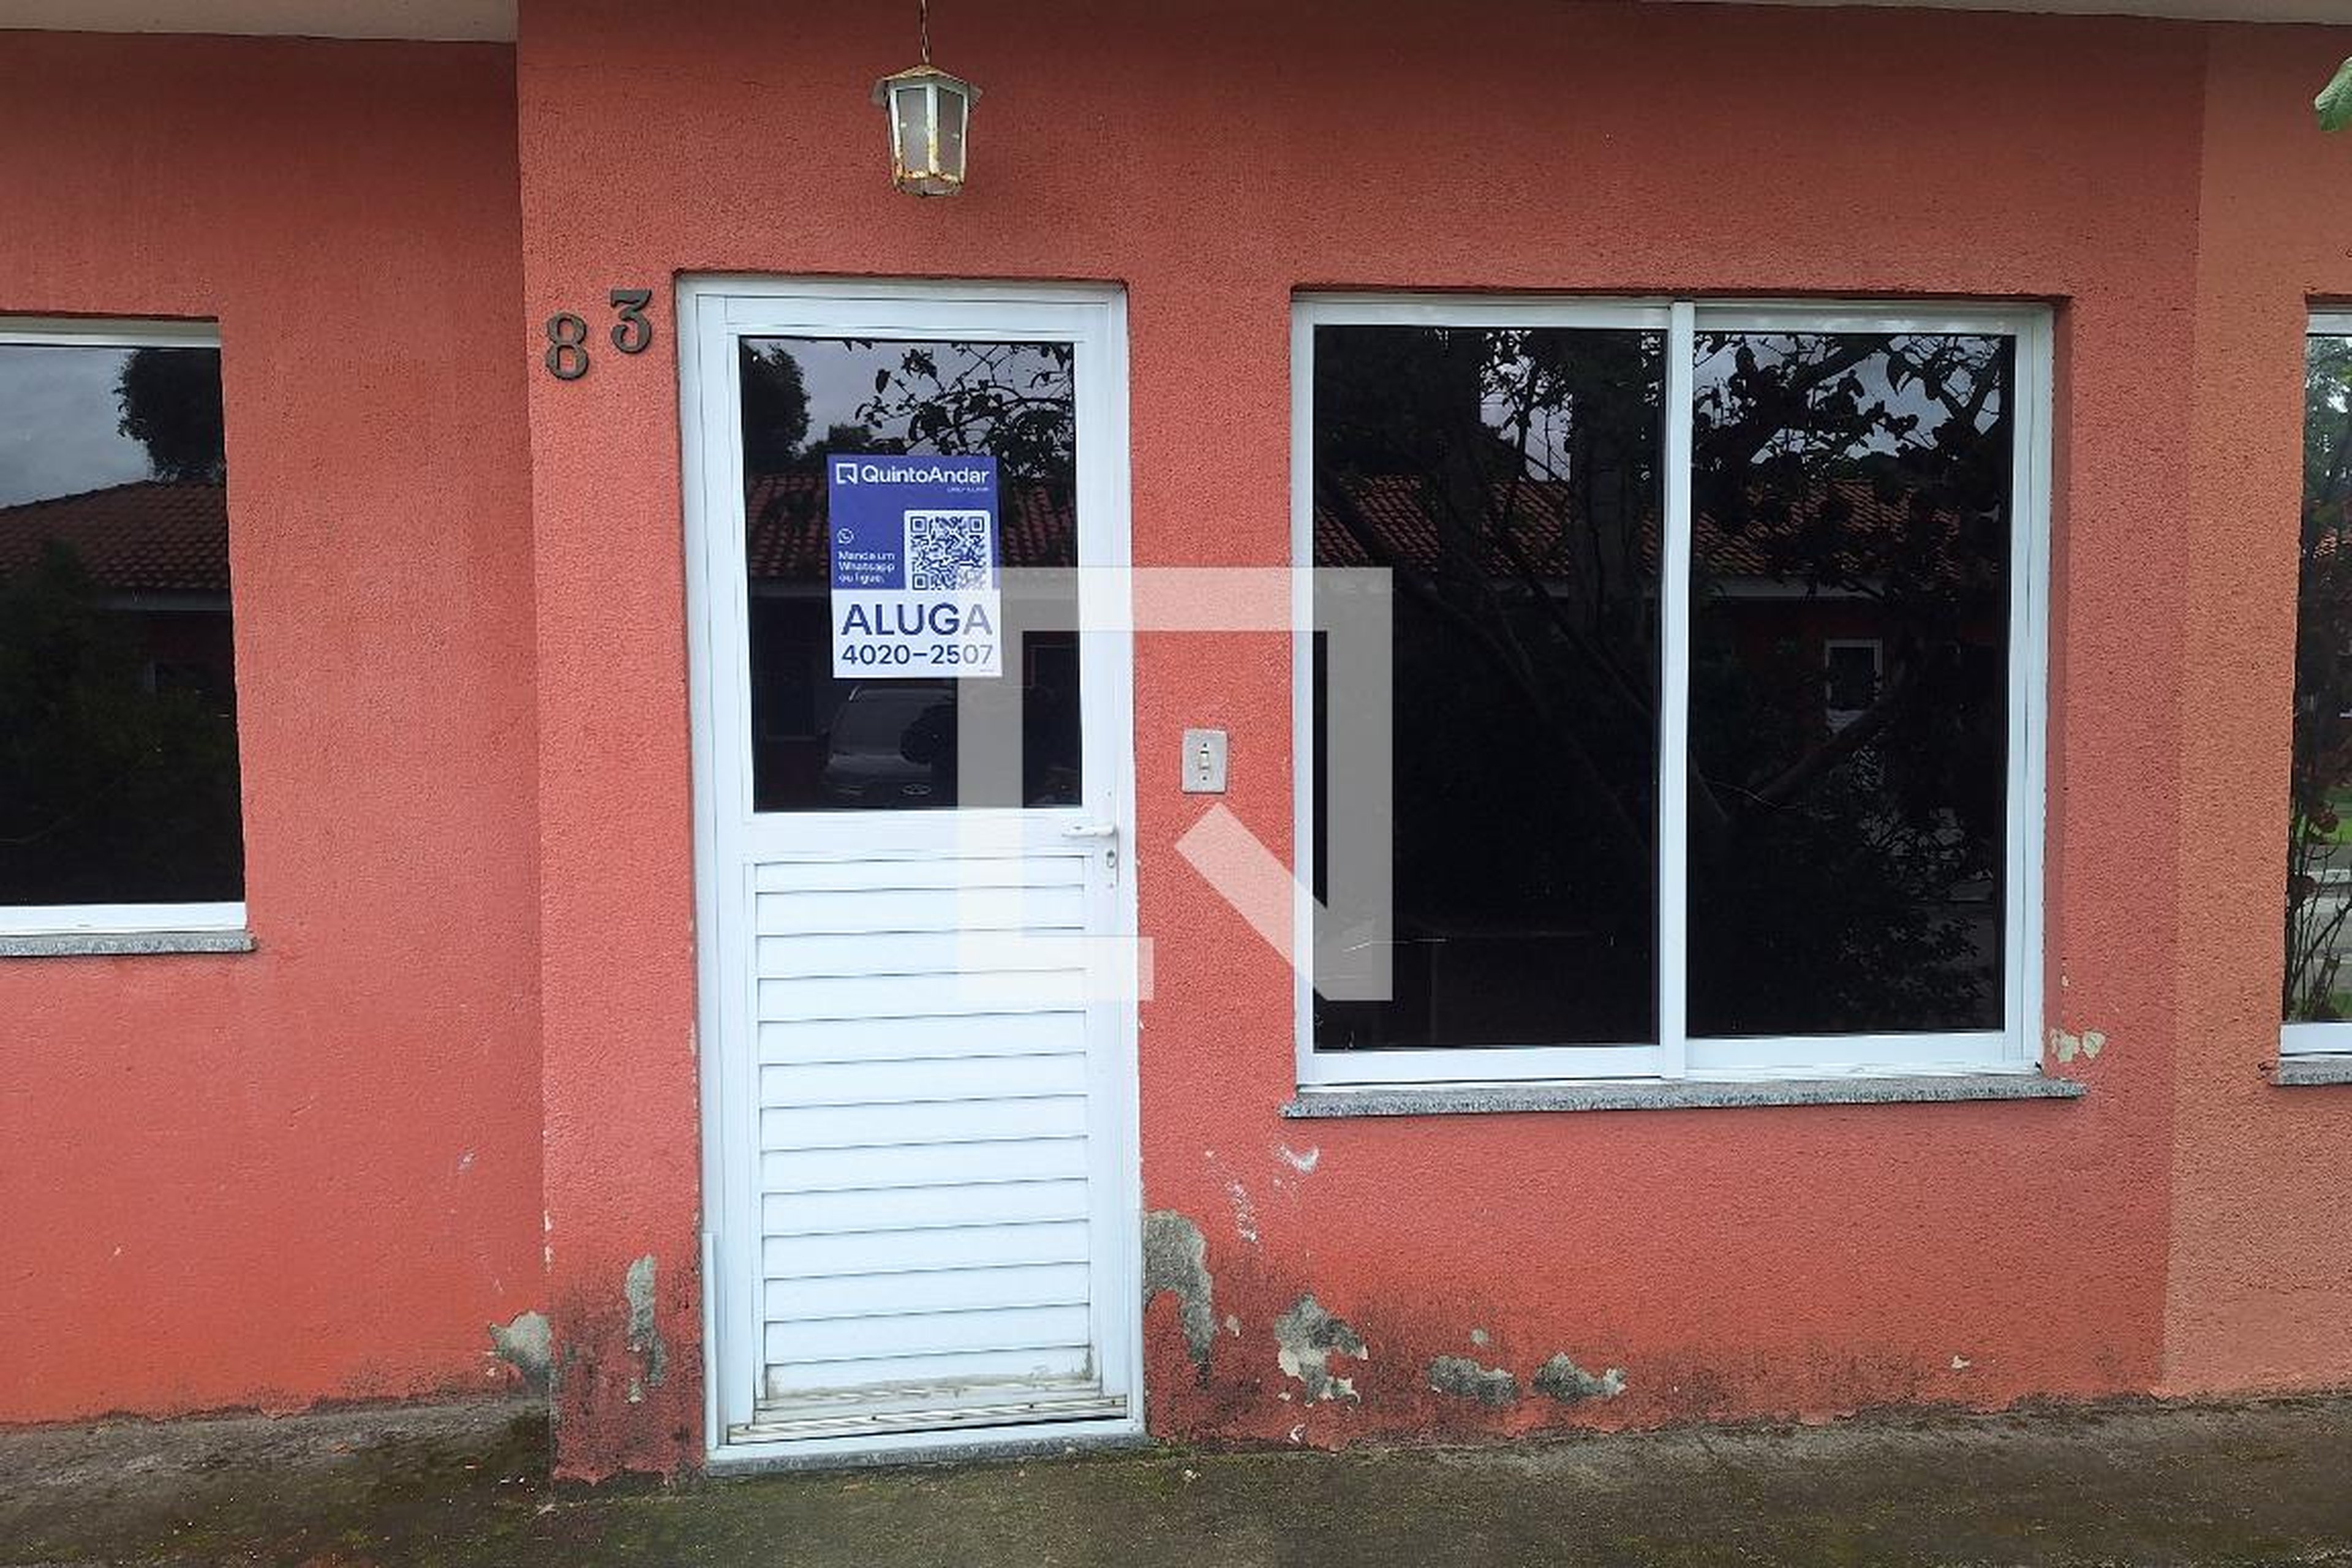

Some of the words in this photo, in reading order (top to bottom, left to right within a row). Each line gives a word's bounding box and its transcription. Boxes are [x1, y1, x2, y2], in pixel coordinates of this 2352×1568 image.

[861, 466, 990, 484] QuintoAndar
[840, 602, 993, 636] ALUGA
[842, 644, 993, 665] 4020-2507
